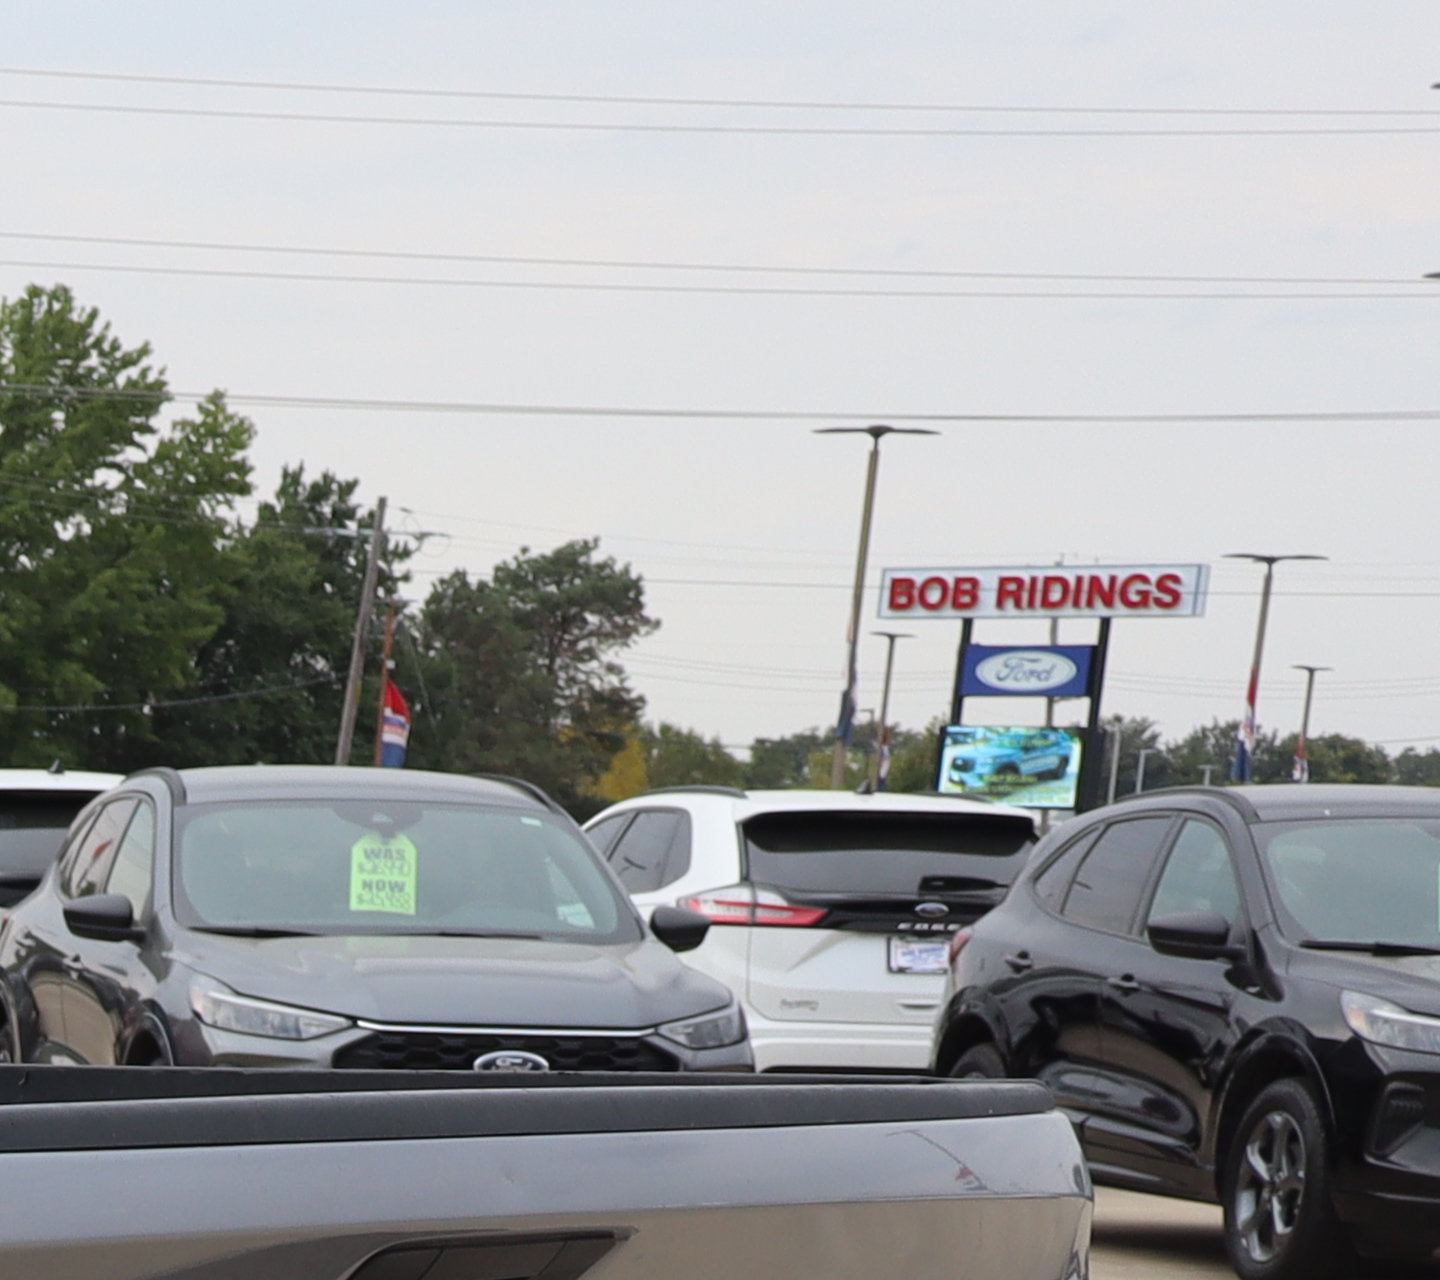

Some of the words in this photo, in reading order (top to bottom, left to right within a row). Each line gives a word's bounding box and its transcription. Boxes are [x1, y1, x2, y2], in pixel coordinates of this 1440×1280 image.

[888, 576, 980, 611] BOB
[995, 573, 1183, 610] RIDINGS
[994, 655, 1058, 684] Ford
[363, 848, 406, 861] WAS
[362, 879, 406, 893] NOW
